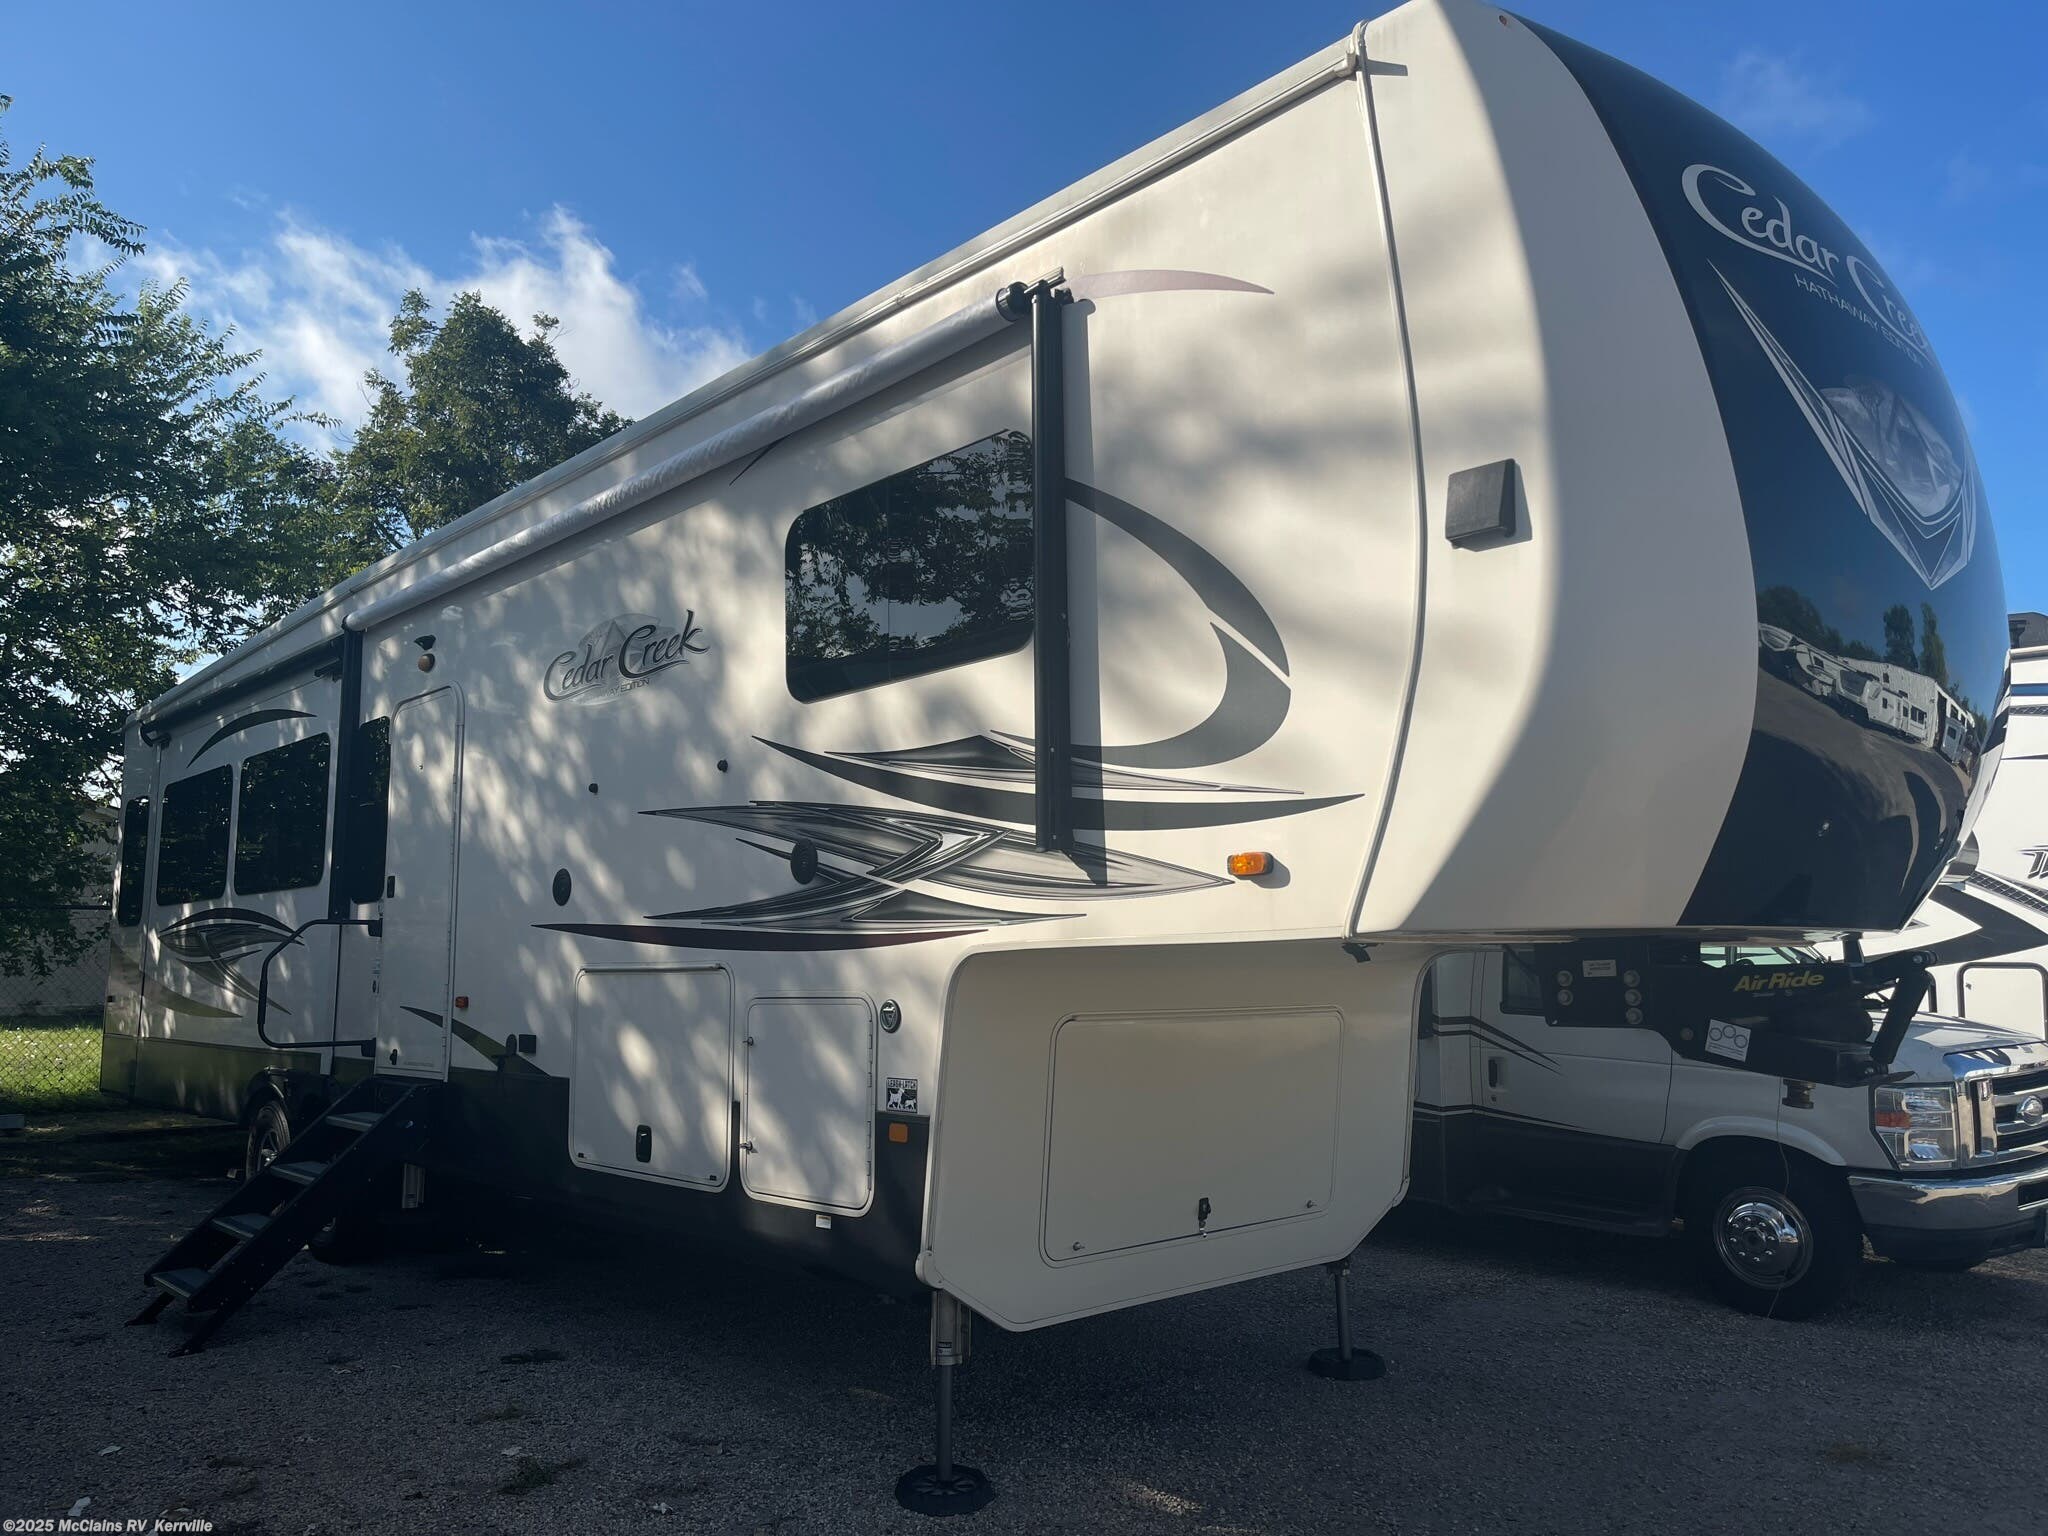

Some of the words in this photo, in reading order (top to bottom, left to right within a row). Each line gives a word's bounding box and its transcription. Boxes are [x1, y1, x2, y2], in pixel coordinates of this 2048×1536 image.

[1682, 163, 1839, 288] Cedar
[543, 643, 614, 703] Cedar
[618, 608, 710, 679] Creek
